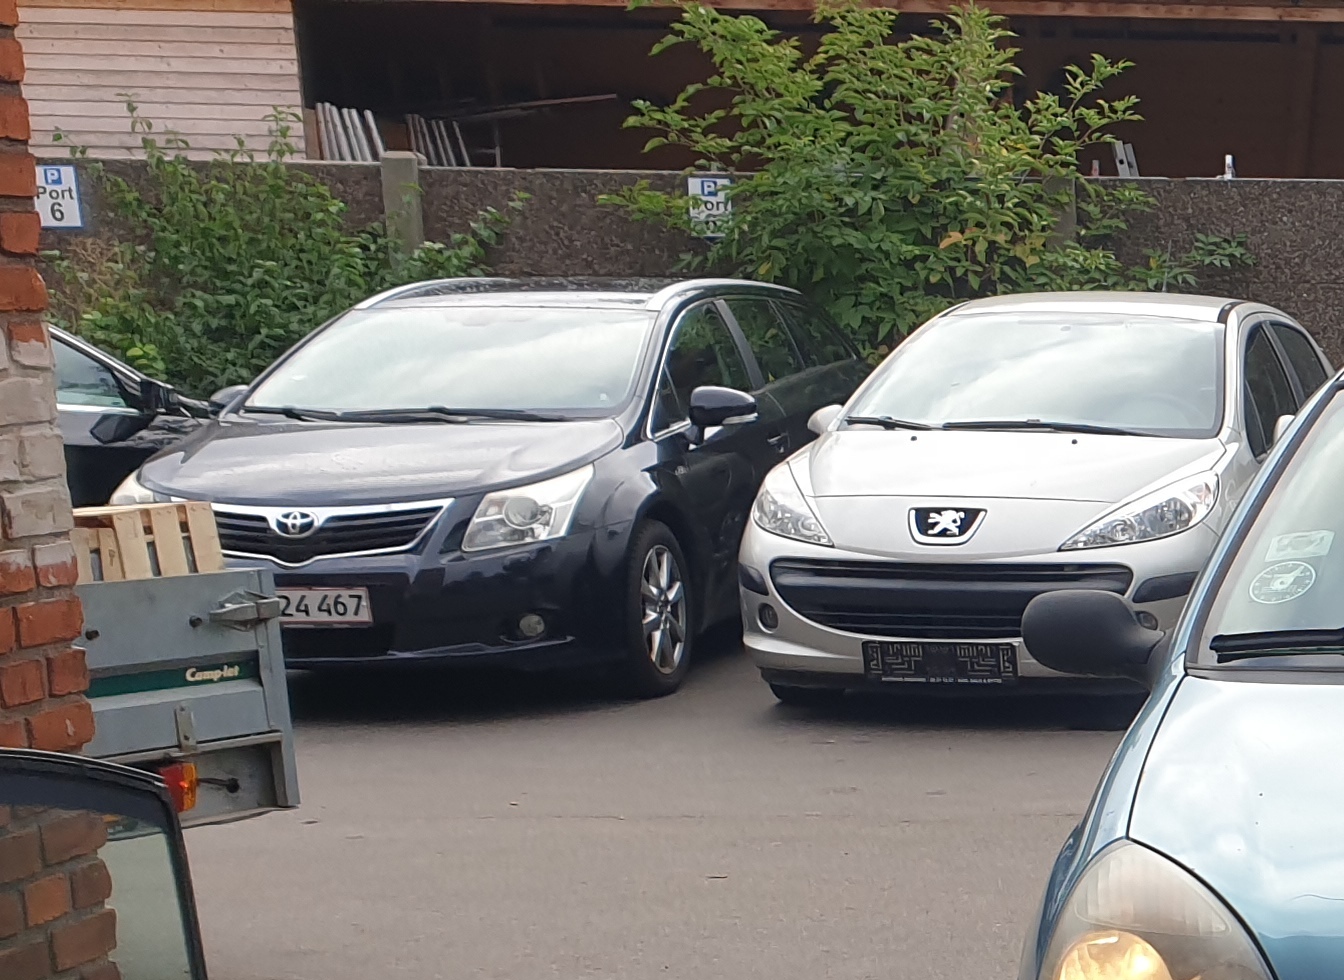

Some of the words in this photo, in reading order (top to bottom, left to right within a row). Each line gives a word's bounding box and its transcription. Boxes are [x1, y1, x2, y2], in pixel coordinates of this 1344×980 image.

[46, 169, 59, 184] P
[37, 186, 74, 200] Port
[50, 202, 65, 222] 6
[277, 594, 310, 617] 24
[317, 593, 363, 617] 467
